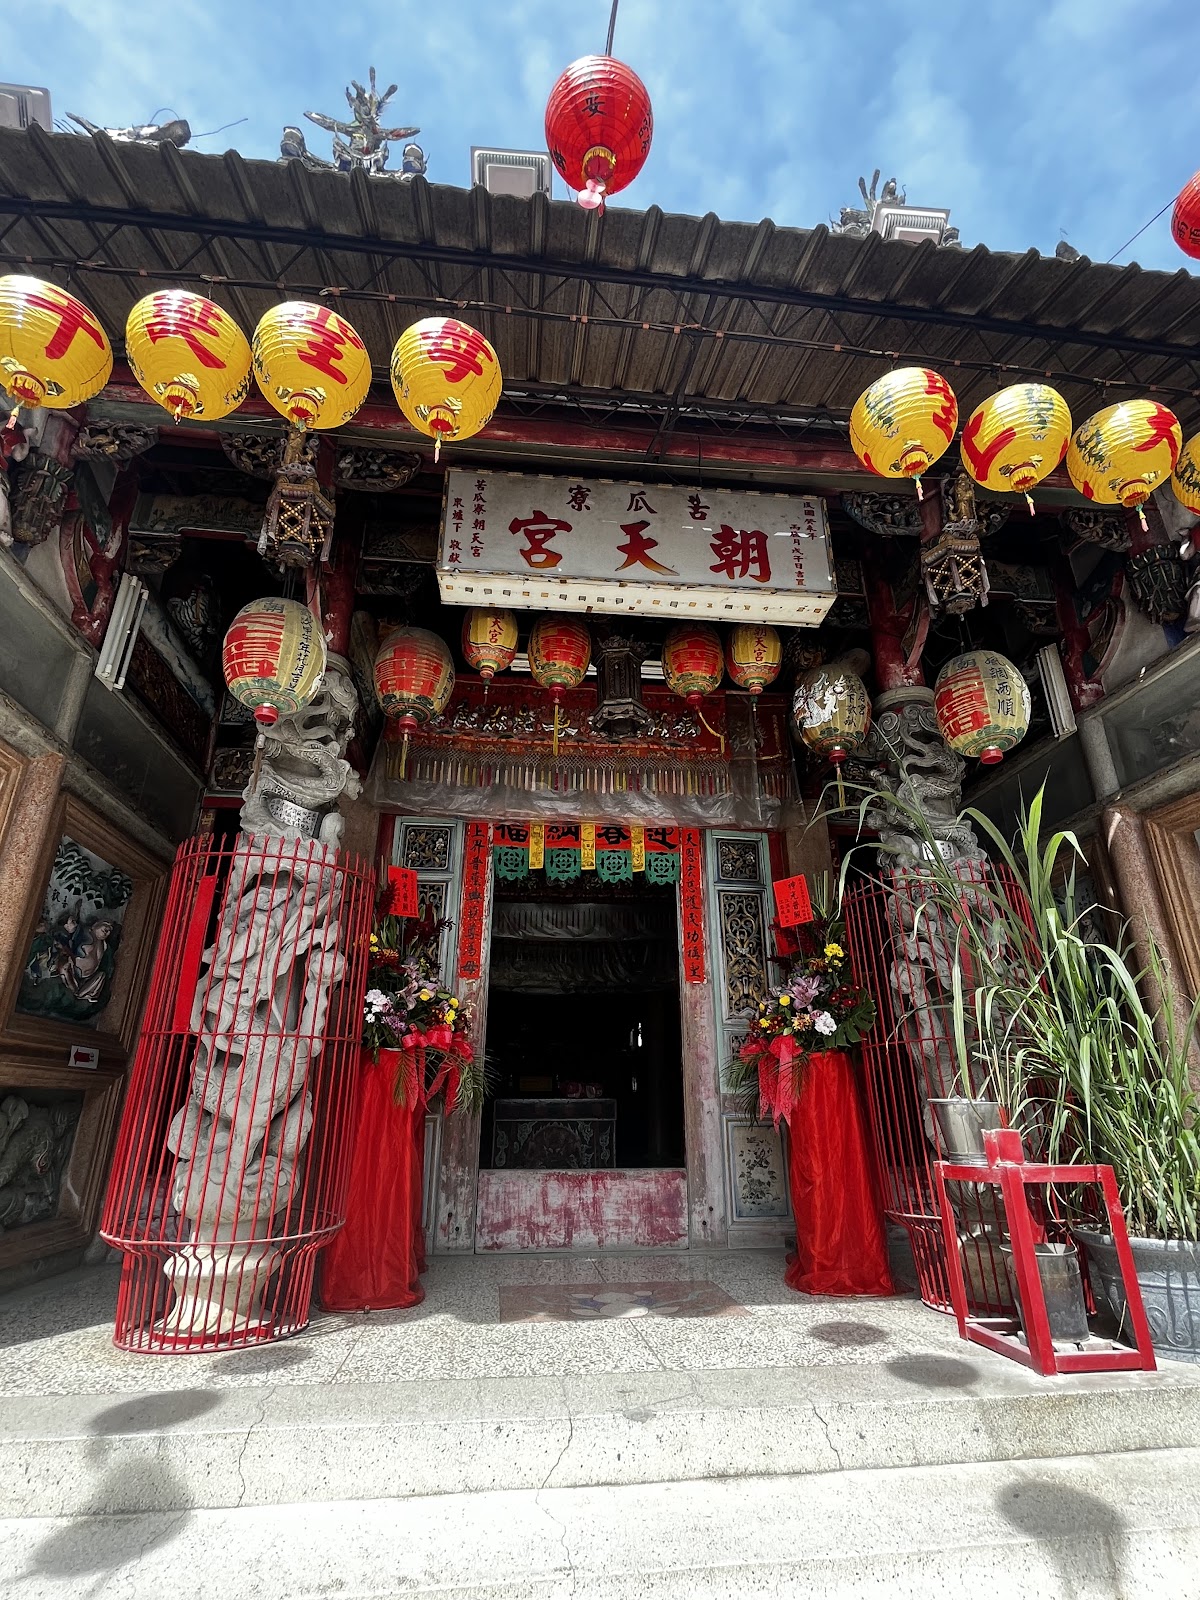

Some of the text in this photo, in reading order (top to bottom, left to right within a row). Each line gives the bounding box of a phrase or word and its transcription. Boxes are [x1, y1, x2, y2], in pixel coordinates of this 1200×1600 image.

[565, 484, 710, 522] 苦瓜寮
[508, 510, 773, 583] 朝天宮
[985, 656, 1015, 717] 風調雨順
